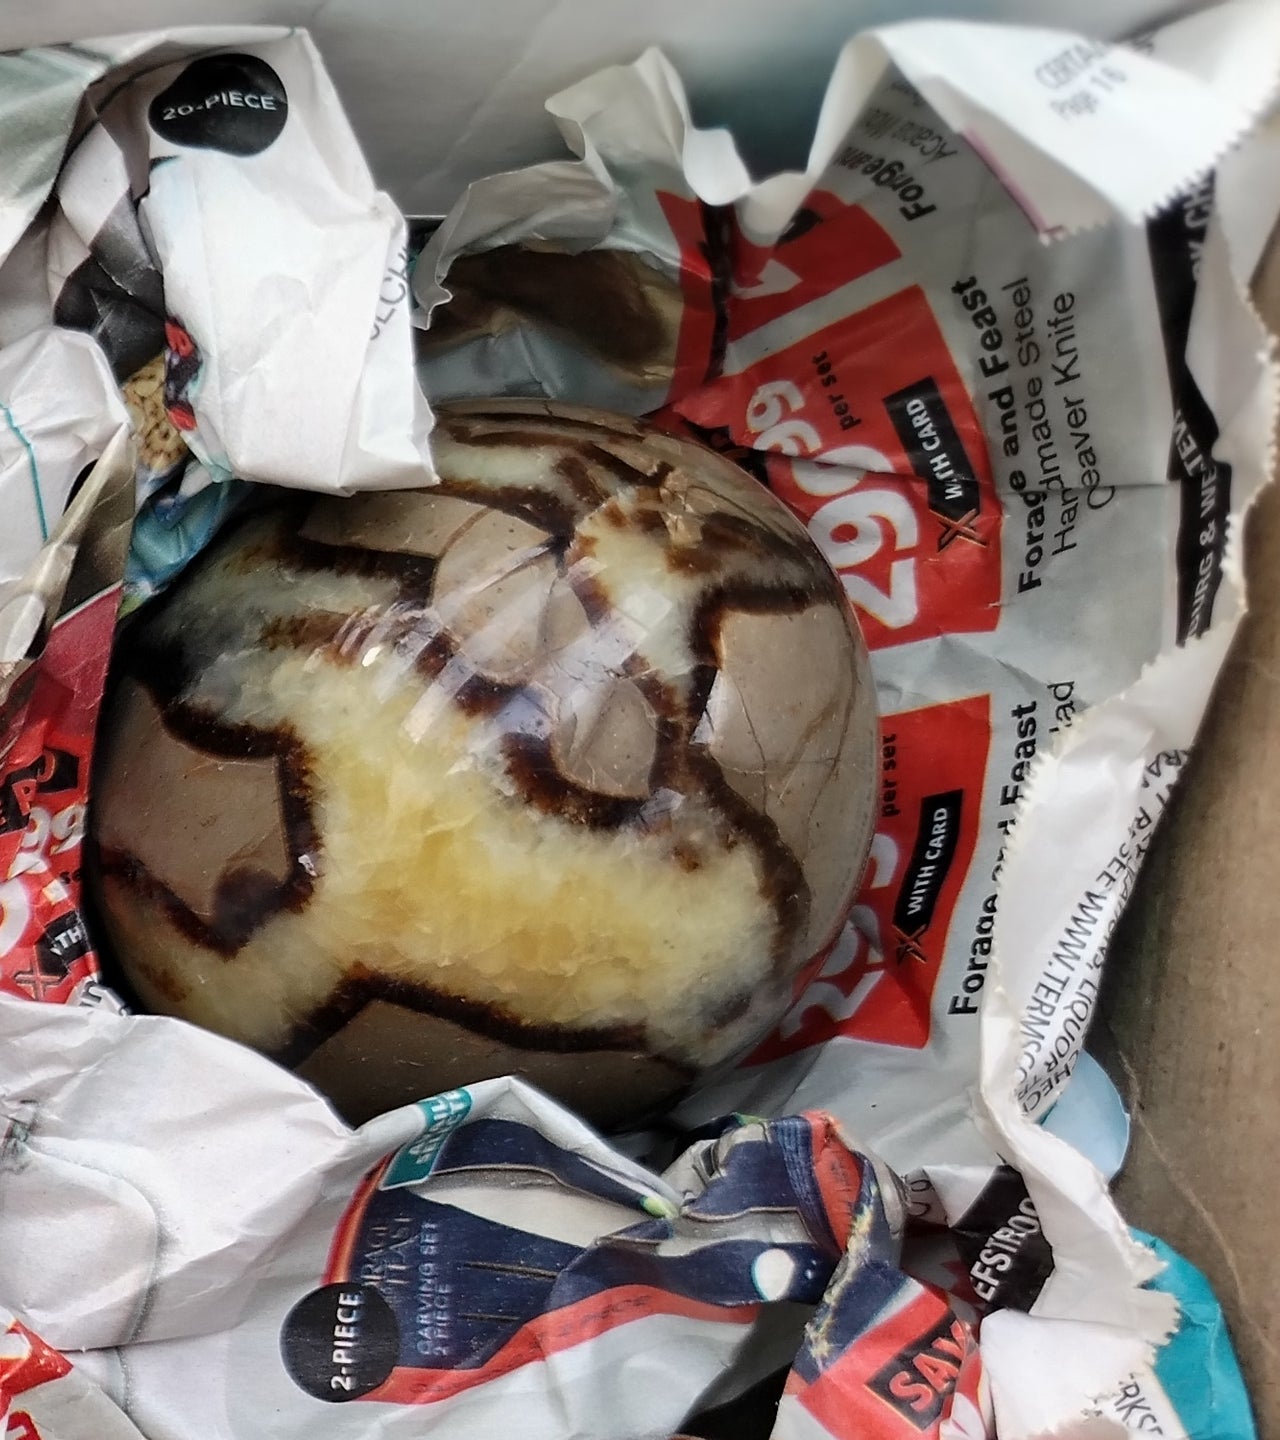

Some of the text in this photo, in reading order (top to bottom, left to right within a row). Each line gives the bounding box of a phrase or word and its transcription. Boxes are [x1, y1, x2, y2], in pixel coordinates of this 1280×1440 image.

[162, 90, 279, 121] 20-PIECE
[1046, 290, 1083, 382] Knife
[812, 350, 863, 432] per set
[907, 398, 942, 457] CARD
[950, 274, 1043, 594] Forage and Feast
[1002, 276, 1077, 556] Handmade Steel
[880, 777, 898, 819] per
[905, 804, 951, 918] WITH CARD
[331, 1290, 361, 1393] 2-PIECE
[887, 1319, 967, 1414] SAV
